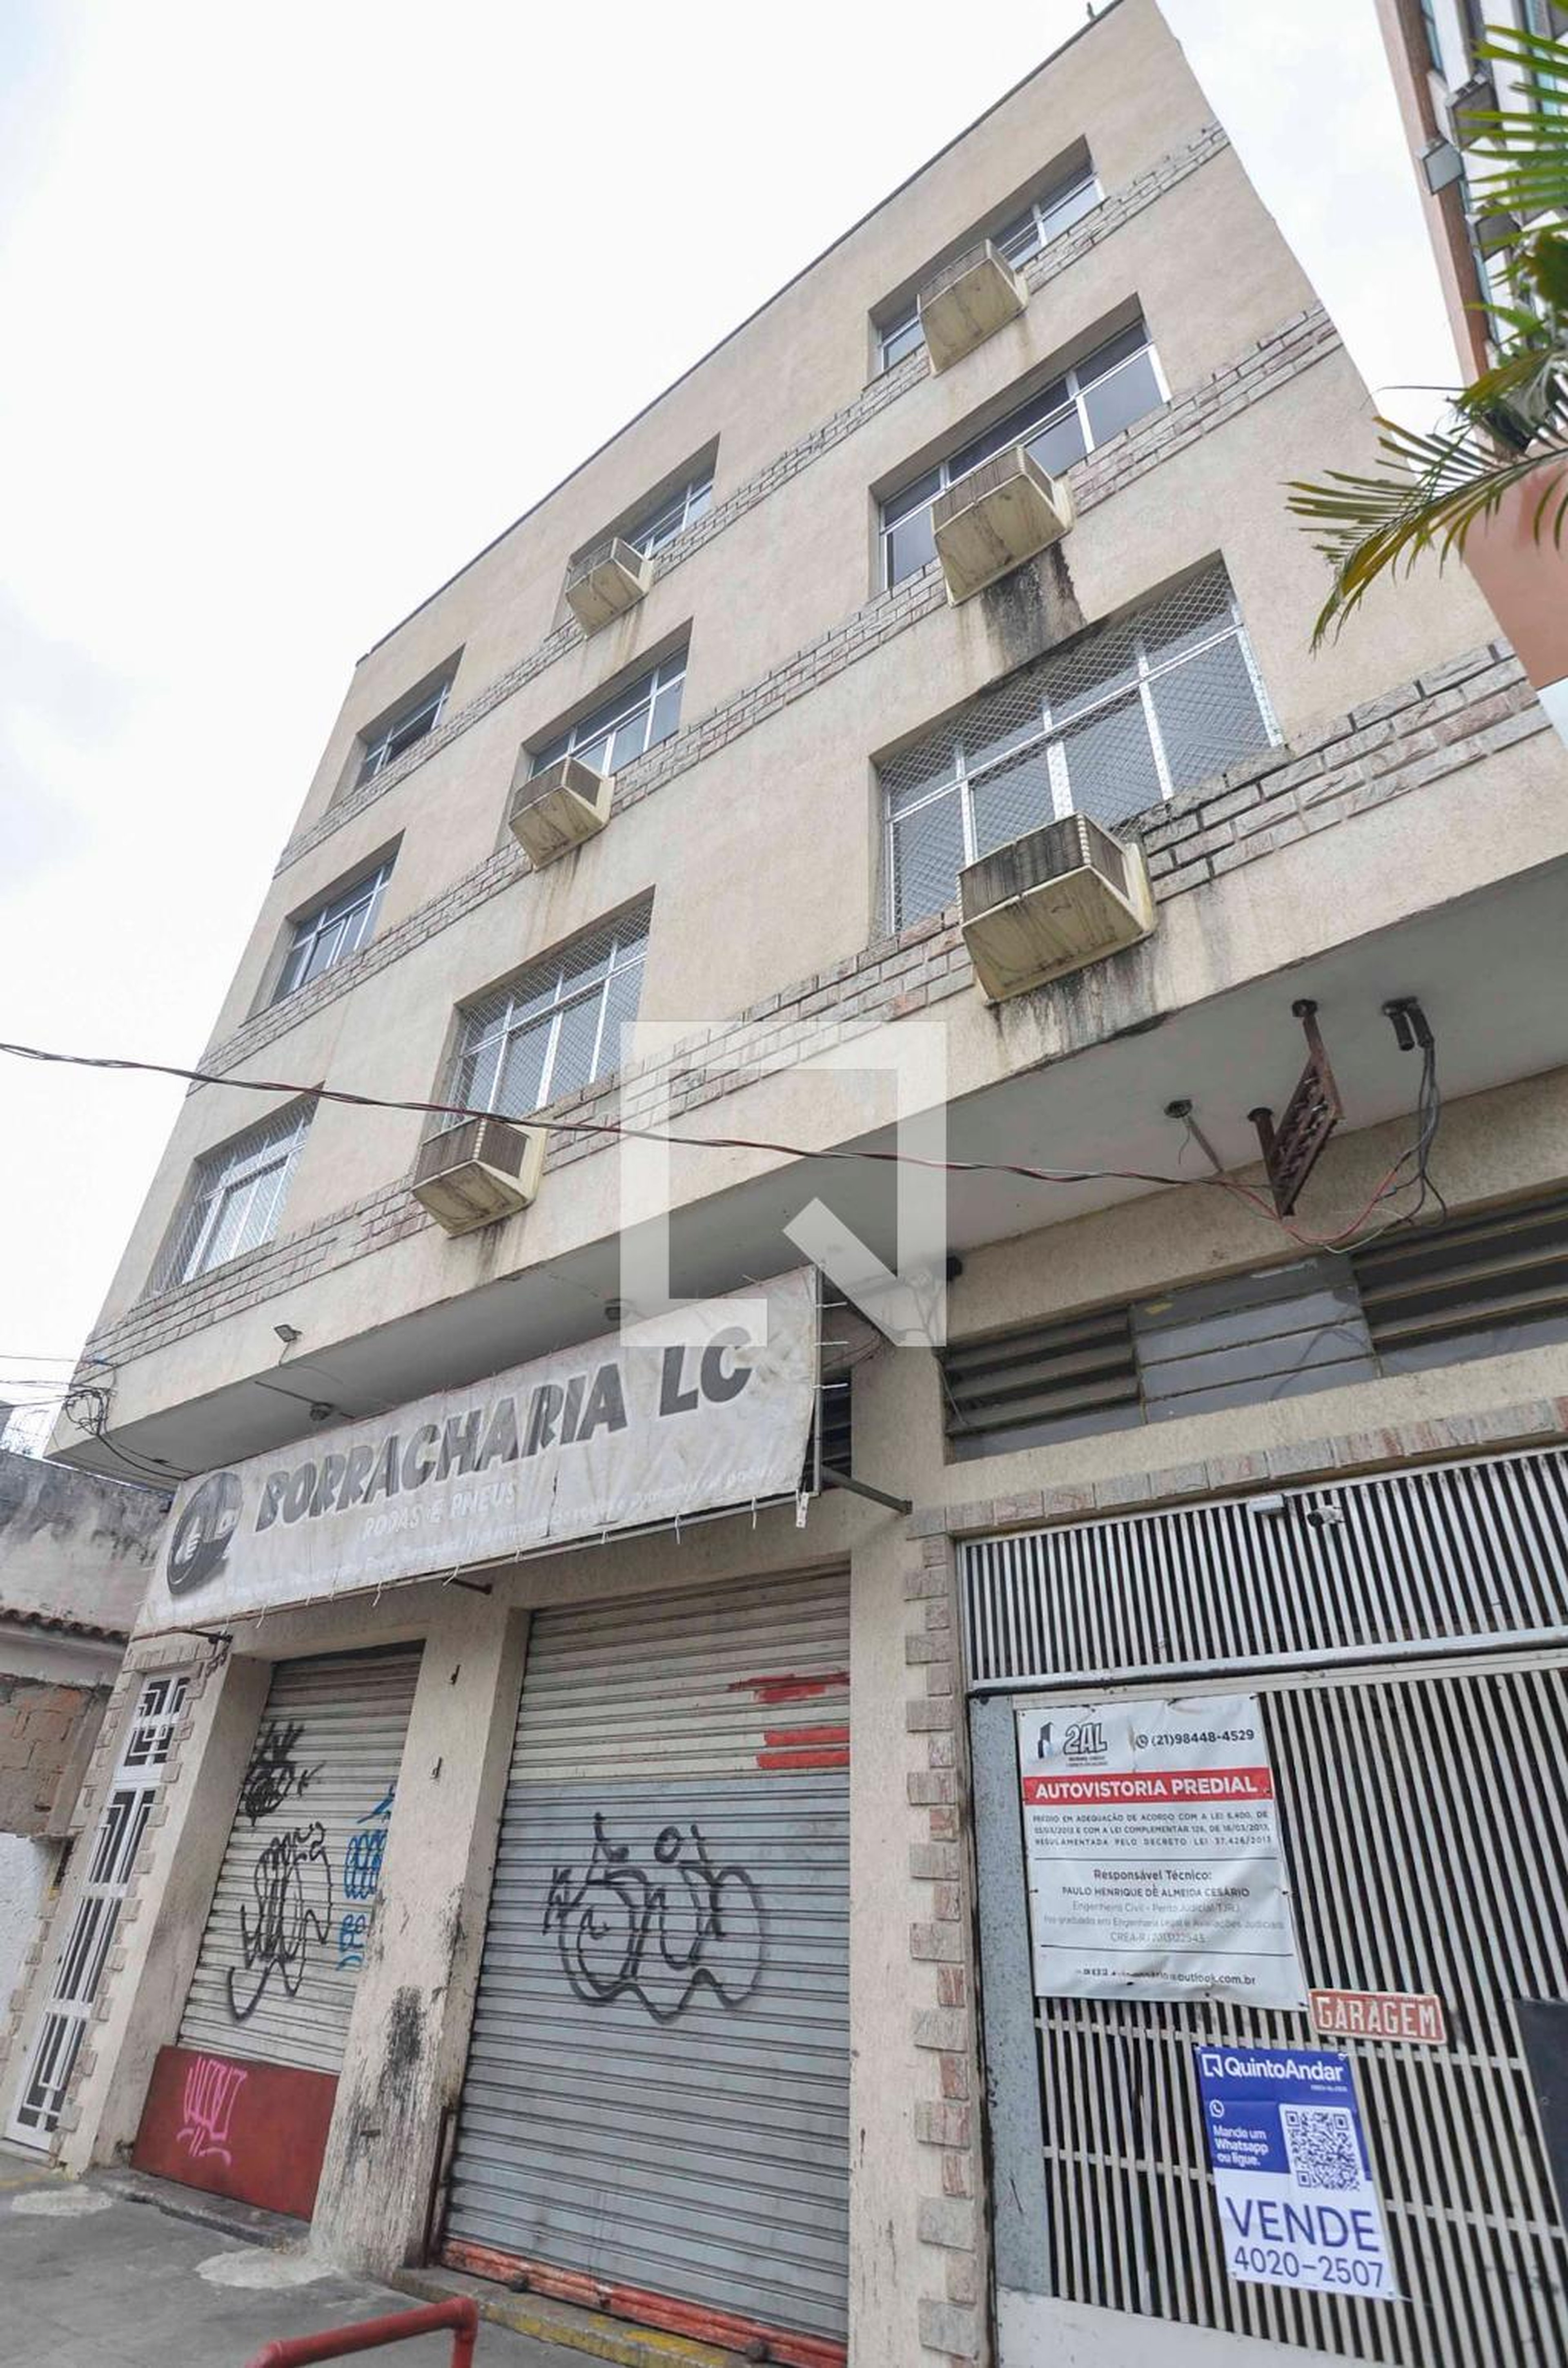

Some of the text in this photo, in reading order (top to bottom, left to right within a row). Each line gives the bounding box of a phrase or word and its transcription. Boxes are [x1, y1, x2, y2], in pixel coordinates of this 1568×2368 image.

[659, 1326, 753, 1417] LC
[1063, 1722, 1255, 1755] 2AL (21)98448-4529
[1035, 1775, 1258, 1799] AUTOVISTORIA PREDIAL
[1256, 1811, 1268, 1819] DE
[1094, 1869, 1212, 1880] Responsável Técnico:
[1062, 1886, 1092, 1896] PAULO
[1095, 1887, 1143, 1897] HENRIQUE
[1162, 1888, 1201, 1897] ALMEIDA
[1316, 1996, 1439, 2038] GARAGEM
[1225, 2057, 1344, 2082] QuintoAndar
[1212, 2125, 1267, 2141] Manda um
[1214, 2138, 1269, 2156] Whatsapp
[1225, 2196, 1380, 2252] VENDE
[1234, 2245, 1383, 2288] 4020-2507
